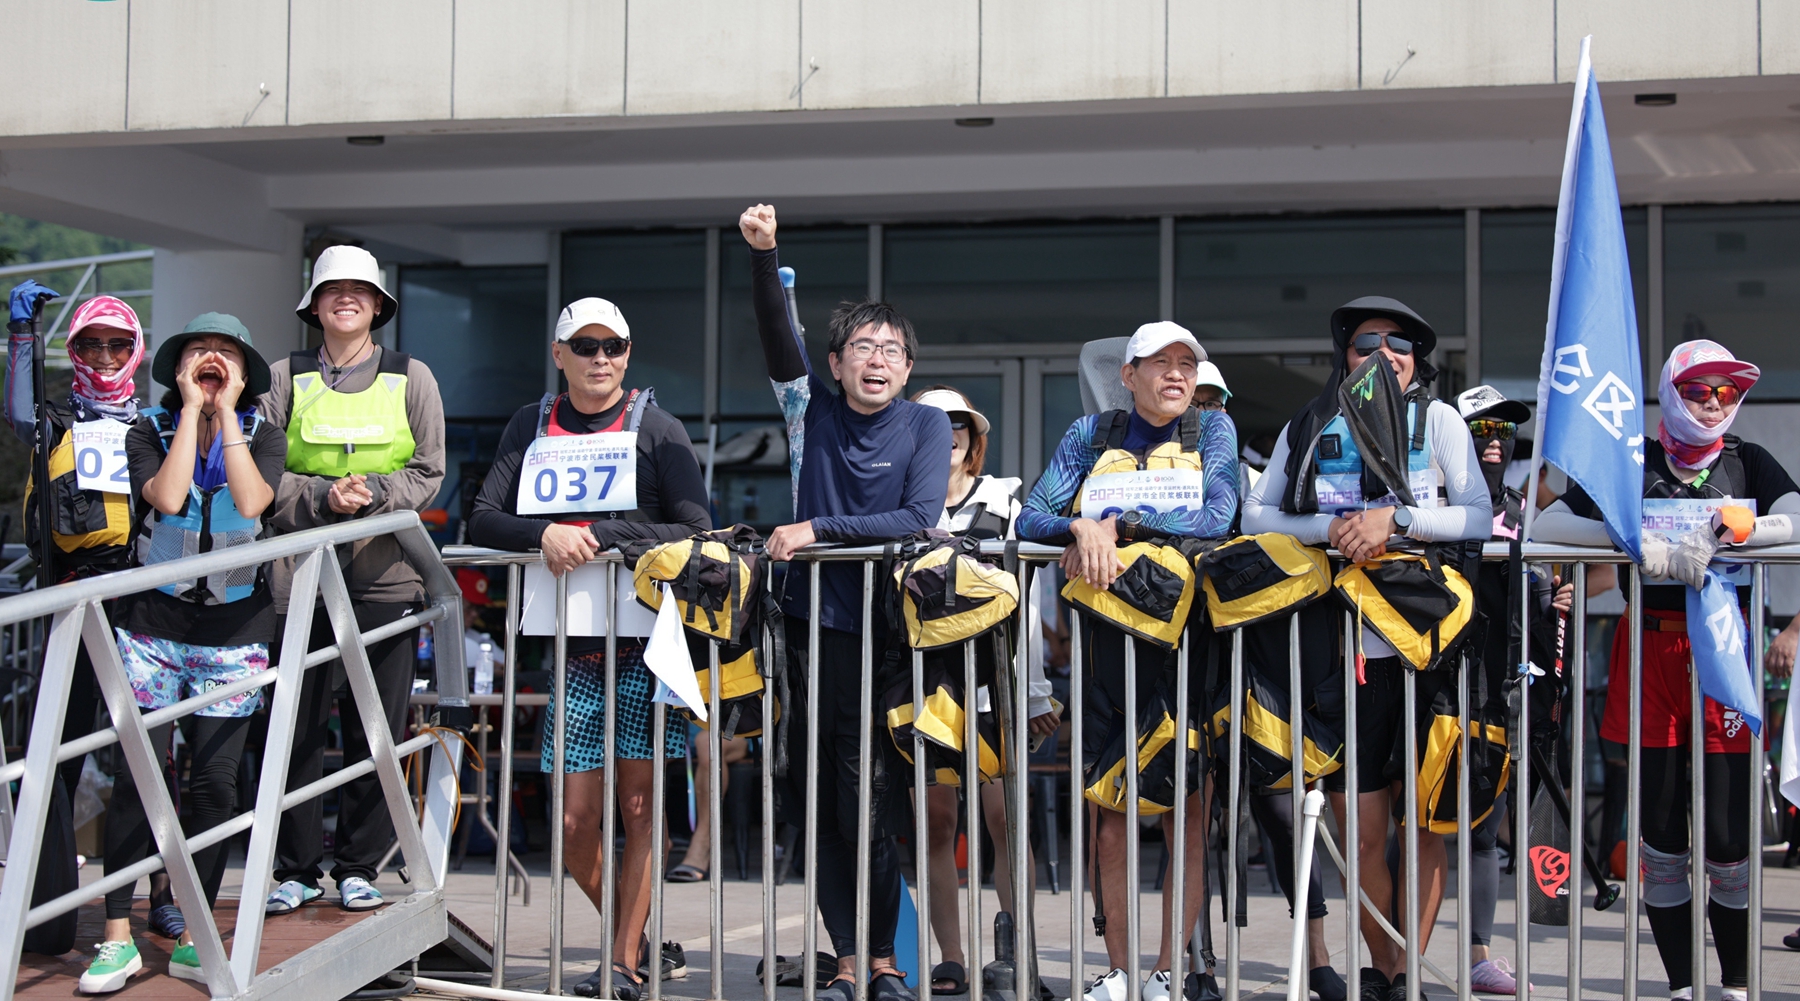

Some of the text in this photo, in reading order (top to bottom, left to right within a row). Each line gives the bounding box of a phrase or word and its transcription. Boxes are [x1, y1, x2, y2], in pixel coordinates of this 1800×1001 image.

[528, 450, 559, 466] 2023
[559, 452, 629, 463] 宁波市全民桨板联赛
[534, 465, 618, 502] 037
[1089, 487, 1124, 501] 2023
[1125, 491, 1200, 500] 宁波市全民桨板联赛
[1318, 490, 1353, 505] 2023
